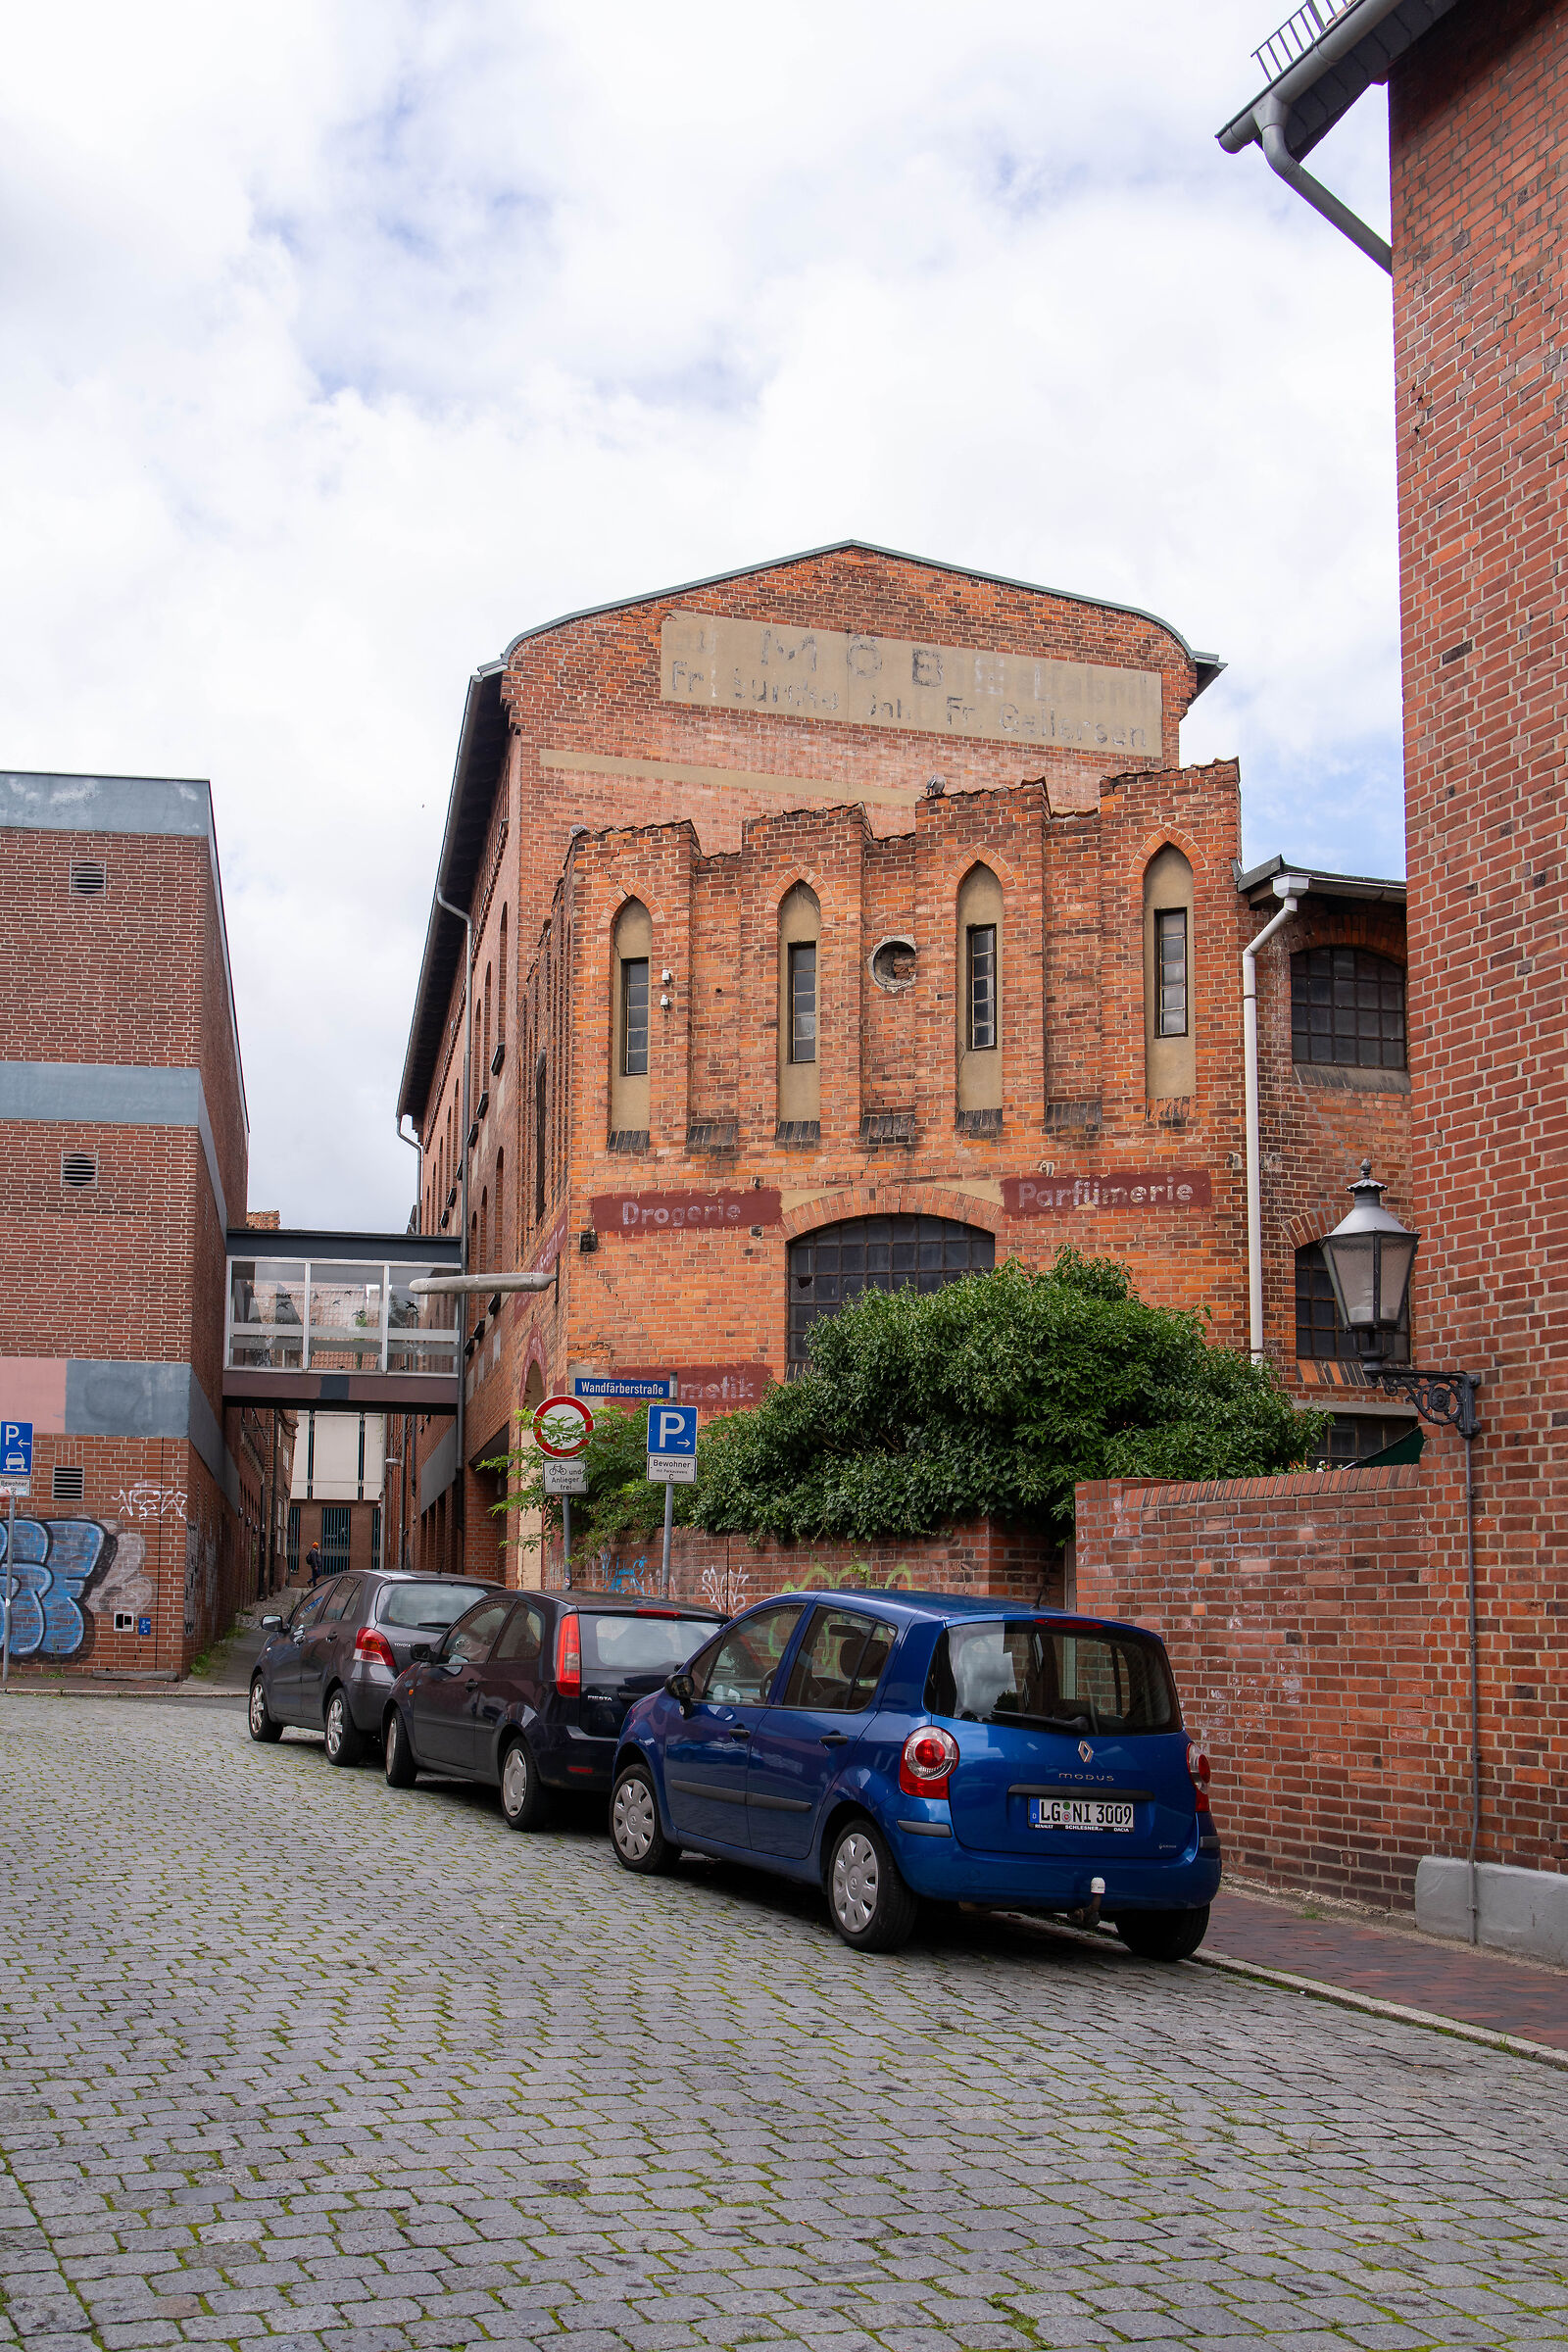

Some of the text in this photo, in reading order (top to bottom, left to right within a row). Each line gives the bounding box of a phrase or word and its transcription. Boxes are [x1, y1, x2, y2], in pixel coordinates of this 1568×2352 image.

[1018, 1175, 1194, 1208] Parfümerie
[622, 1198, 741, 1227] Drogerie
[581, 1381, 663, 1396] Wandfärberstraße
[680, 1374, 755, 1399] metik
[6, 1425, 20, 1446] P
[659, 1411, 686, 1447] P
[653, 1459, 691, 1468] Bewohner
[1041, 1801, 1132, 1825] LG NI 3009
